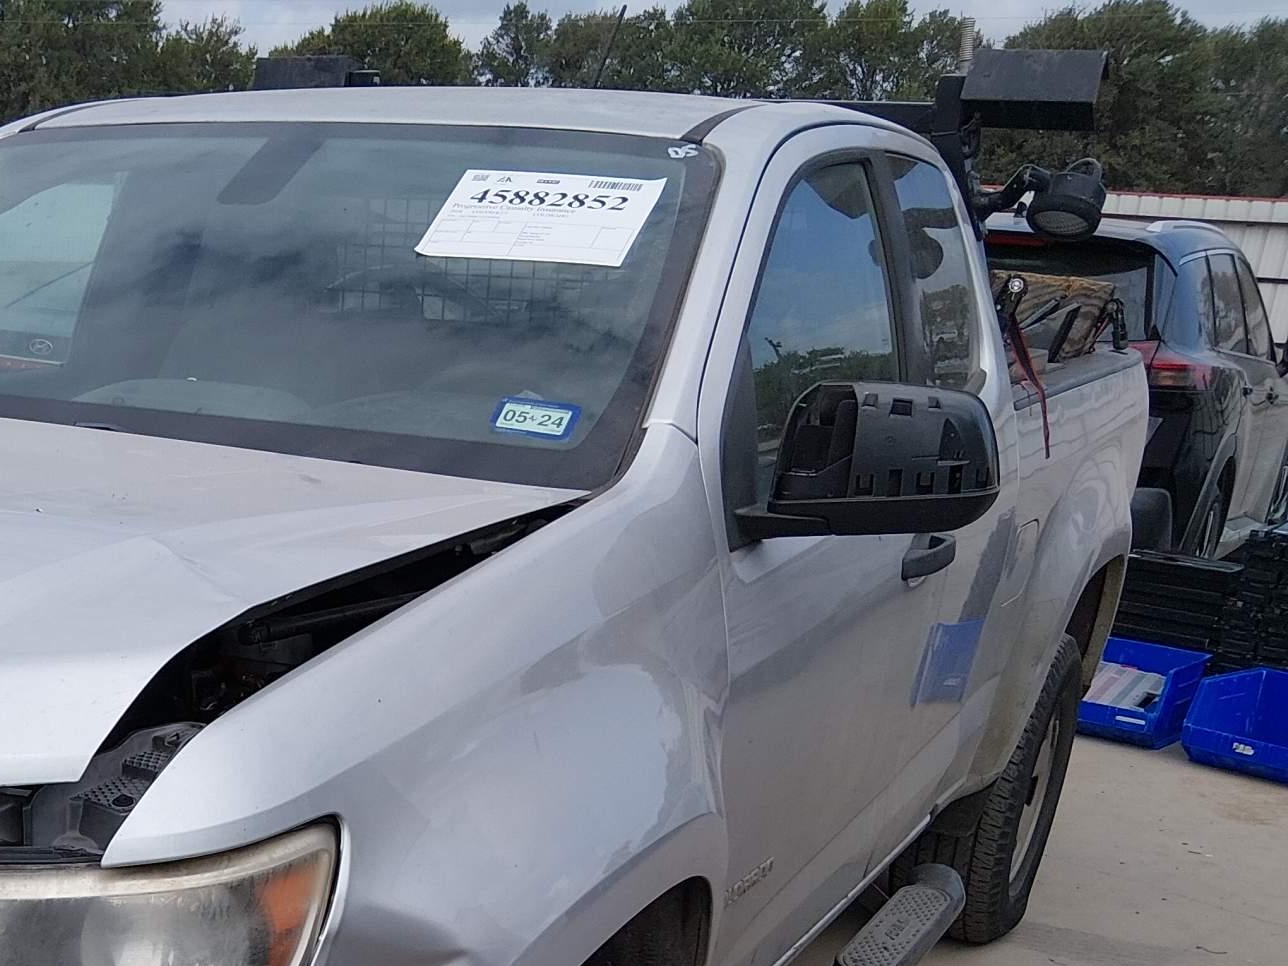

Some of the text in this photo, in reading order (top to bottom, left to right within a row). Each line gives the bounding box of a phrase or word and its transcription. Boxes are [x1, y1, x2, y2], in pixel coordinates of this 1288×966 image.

[470, 188, 629, 211] 45882852
[503, 409, 565, 429] 05 24
